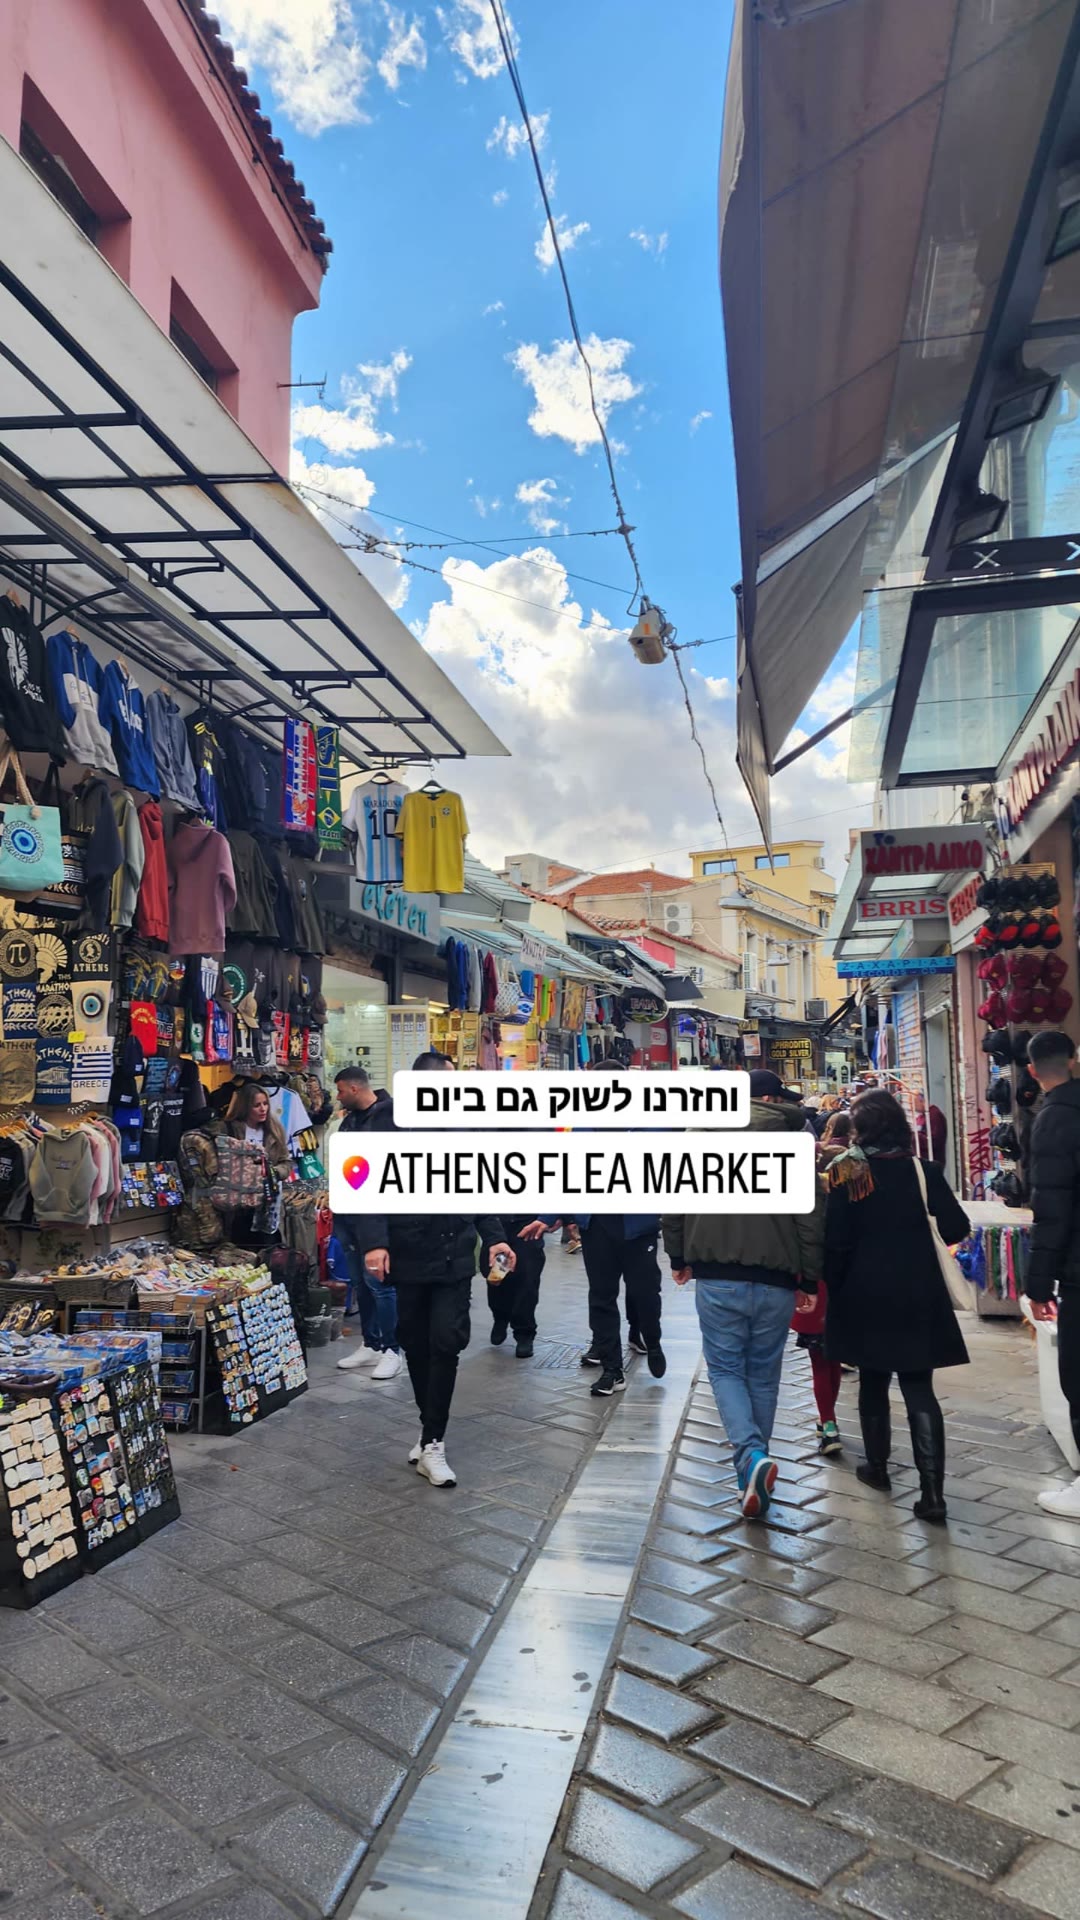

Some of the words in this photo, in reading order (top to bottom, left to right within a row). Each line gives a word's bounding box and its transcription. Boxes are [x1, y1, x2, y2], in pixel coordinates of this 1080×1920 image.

[368, 809, 399, 839] 10
[861, 898, 946, 918] ERRIS
[73, 963, 109, 972] ATHENS
[853, 968, 908, 978] RECORDS
[921, 967, 937, 975] CD
[771, 1049, 787, 1058] GOLD
[789, 1049, 809, 1057] SILVER
[73, 1080, 108, 1088] GREECE
